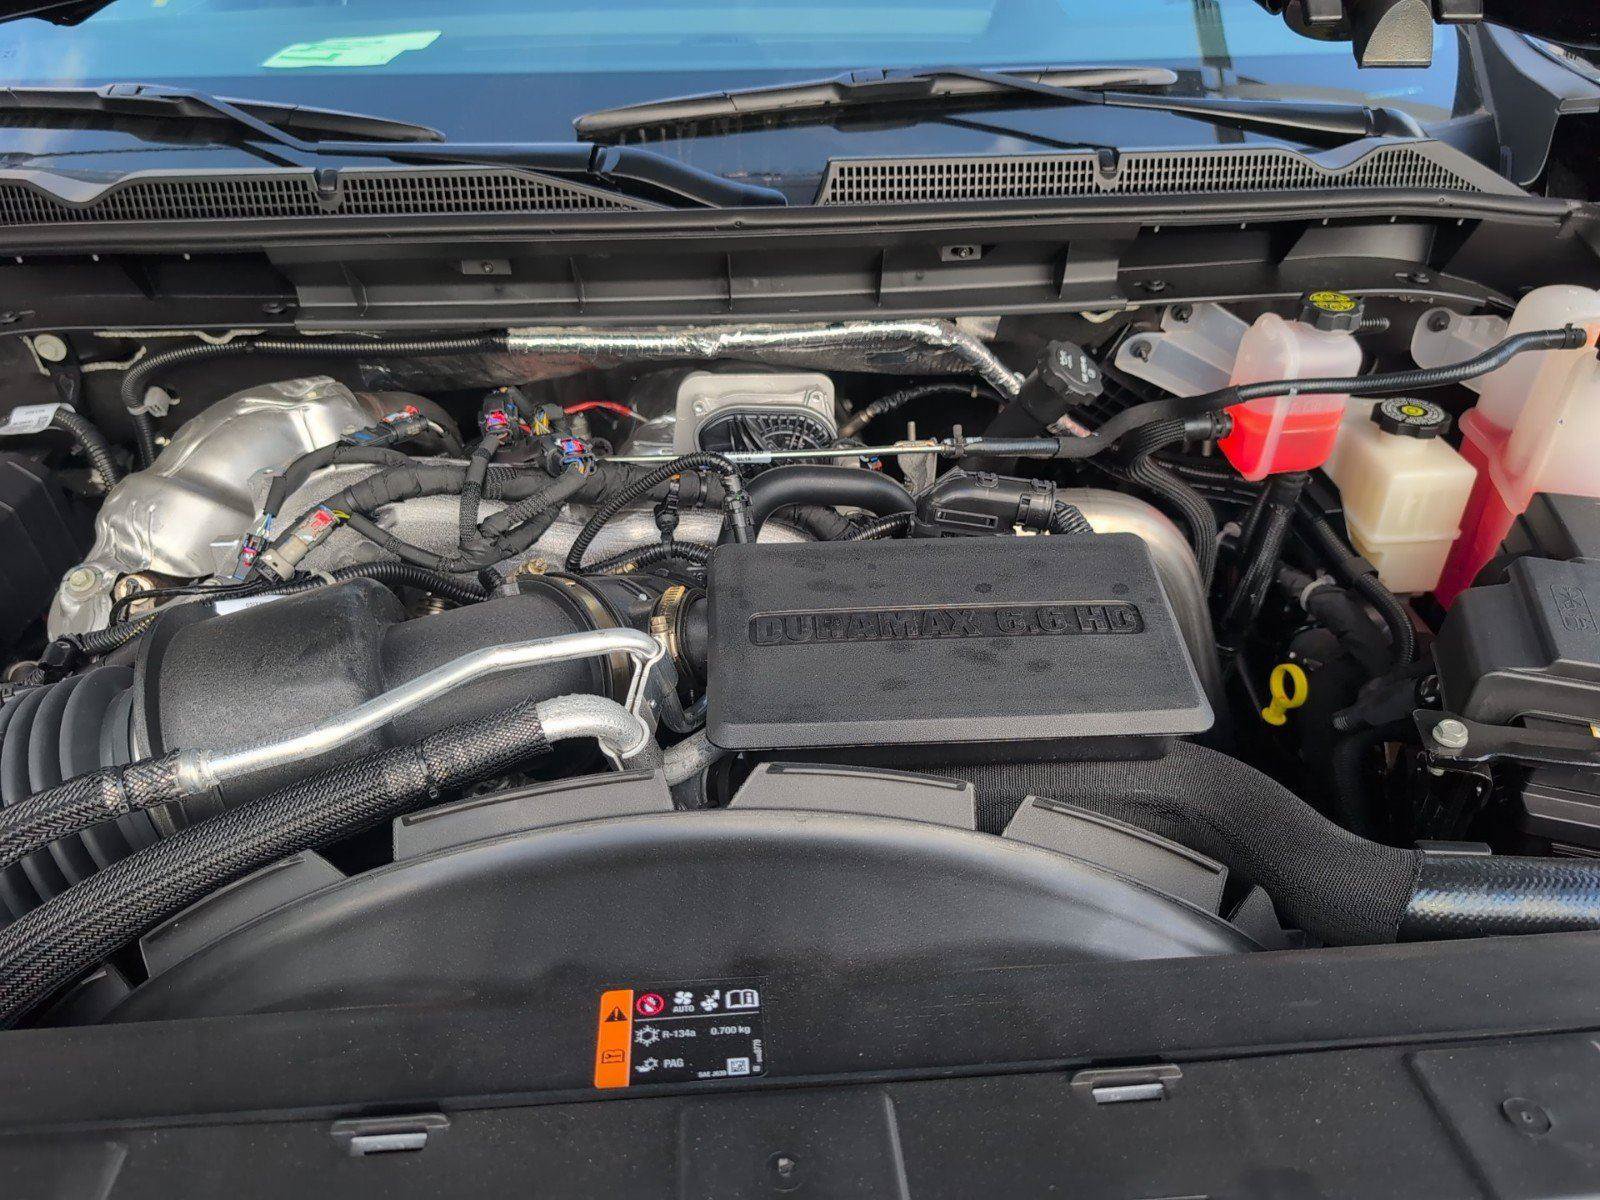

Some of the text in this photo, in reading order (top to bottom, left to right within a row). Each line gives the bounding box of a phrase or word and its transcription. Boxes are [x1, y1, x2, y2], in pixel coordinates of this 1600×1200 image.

[755, 605, 1139, 643] DURAMAX 6.6 HD
[672, 1005, 696, 1014] AUTO
[661, 1029, 697, 1039] R-134a
[710, 1025, 752, 1036] 0.700 kg
[662, 1058, 685, 1069] PAG
